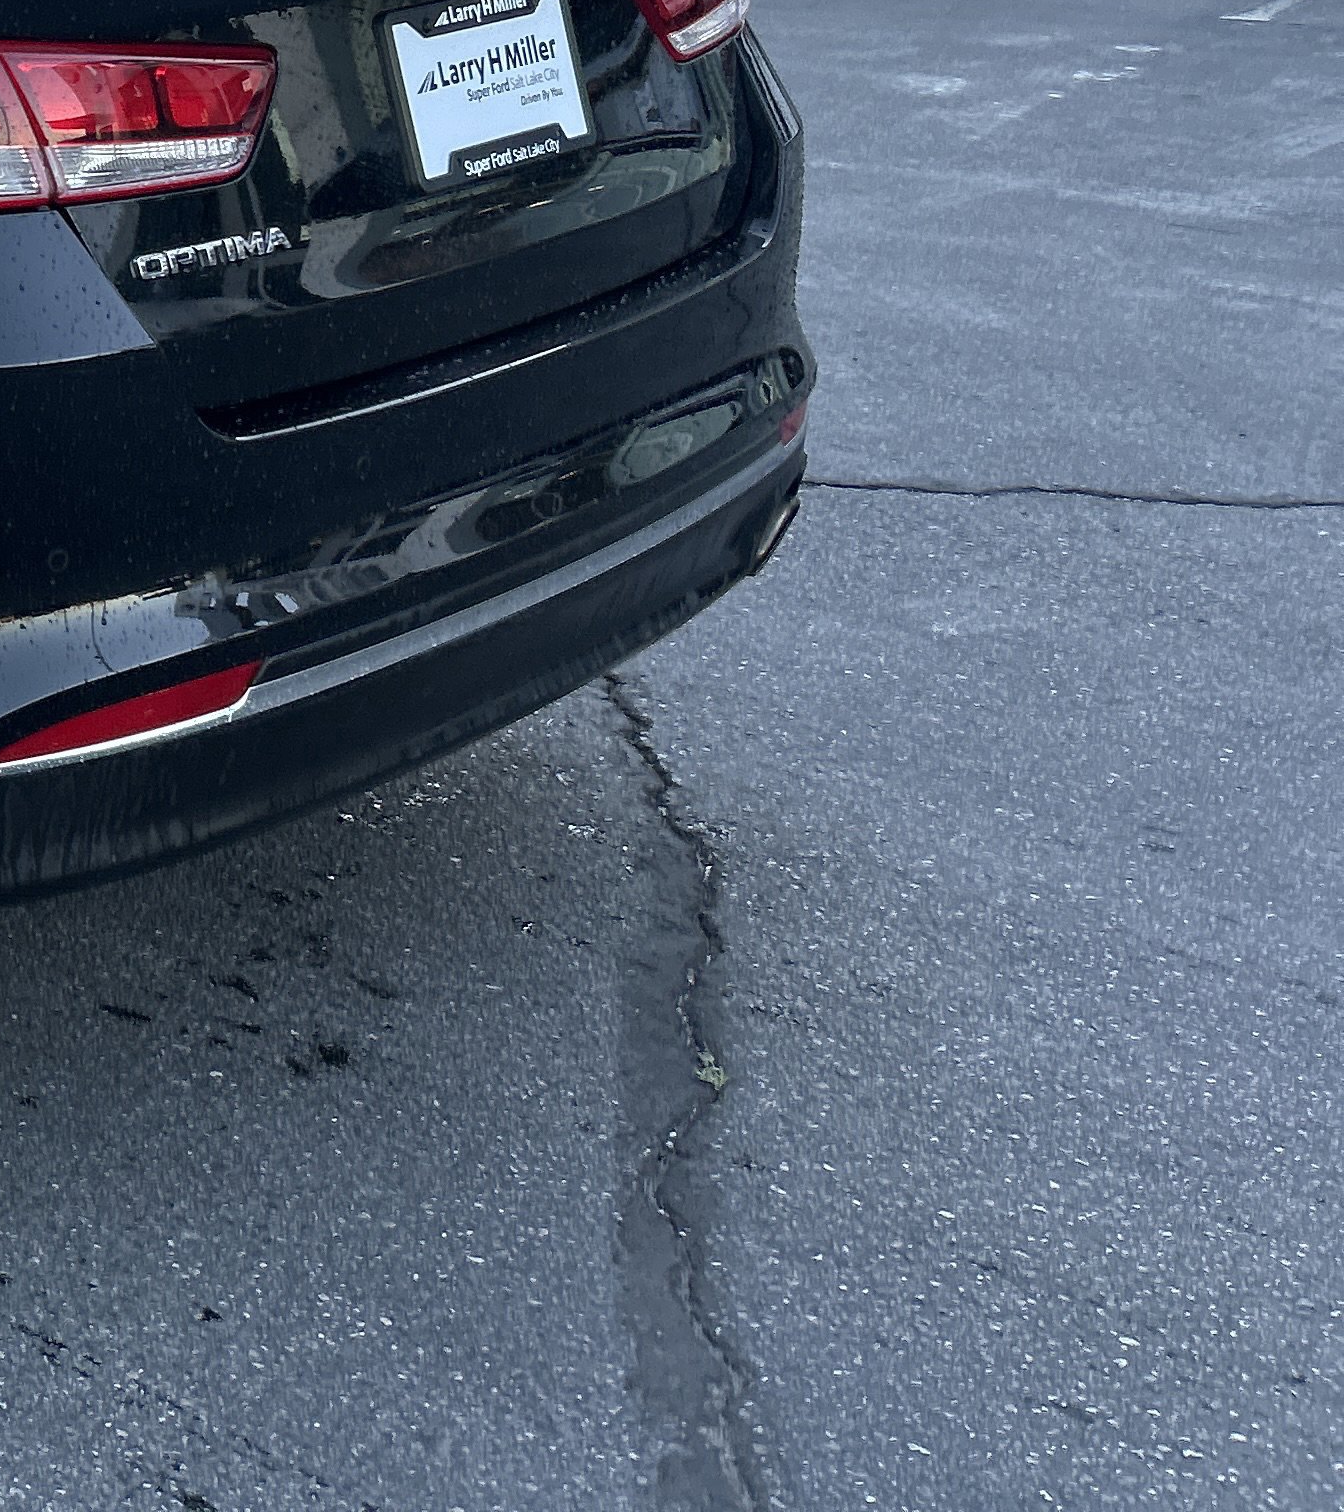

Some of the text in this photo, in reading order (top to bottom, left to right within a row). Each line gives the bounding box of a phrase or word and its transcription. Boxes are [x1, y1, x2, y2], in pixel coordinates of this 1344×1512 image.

[447, 6, 482, 23] Larry
[437, 34, 556, 88] Larry H Miller
[466, 67, 560, 103] Super Ford Salt Lake City
[464, 138, 560, 177] Super Ford Salt Lake City
[130, 227, 293, 281] OPTIMA
